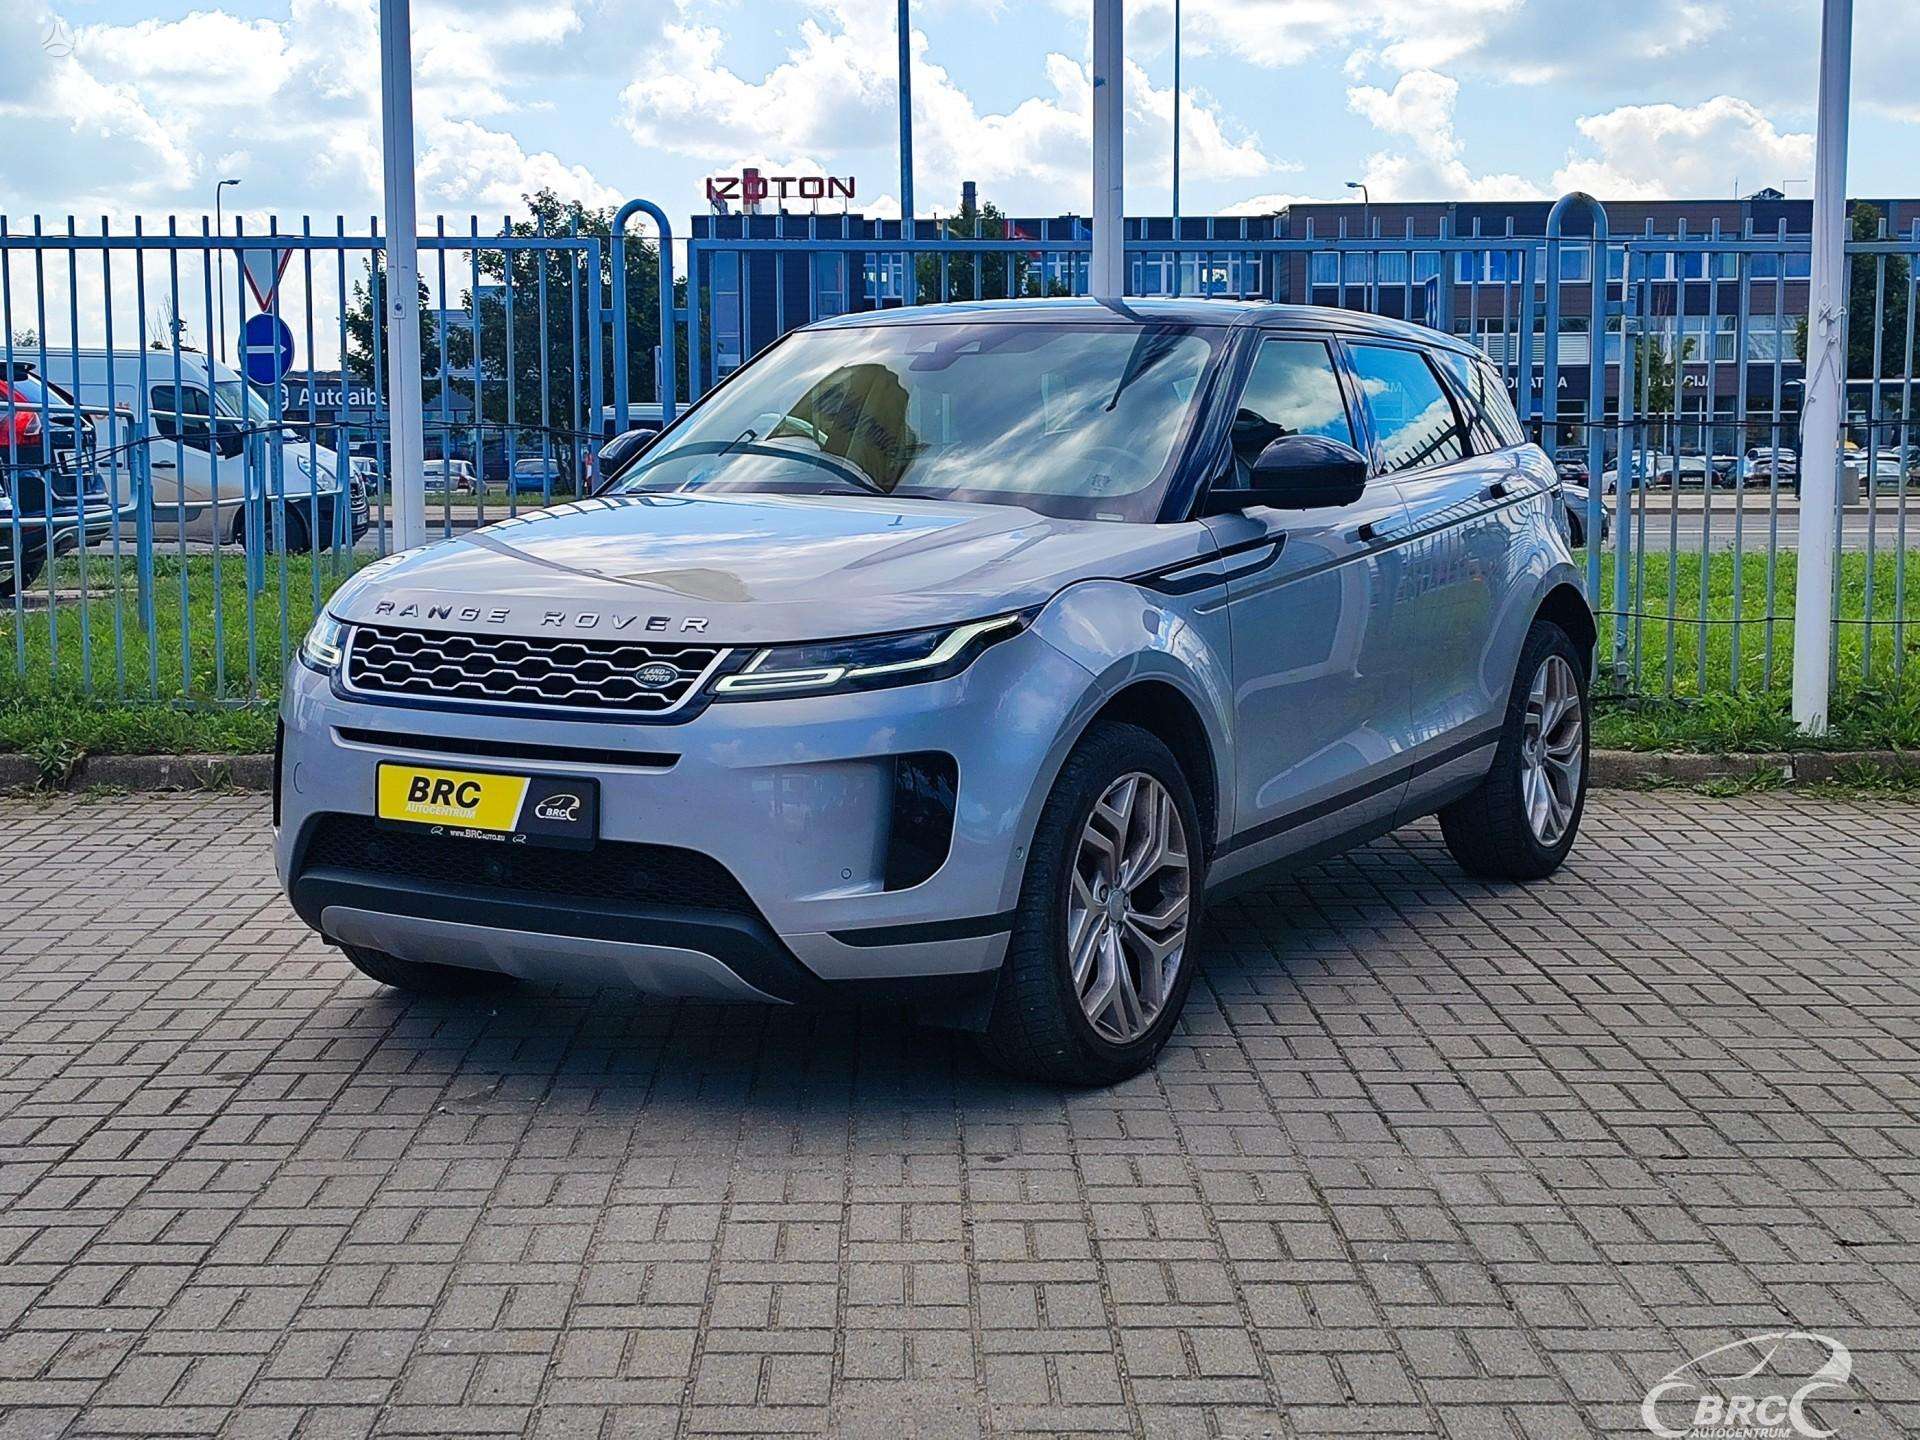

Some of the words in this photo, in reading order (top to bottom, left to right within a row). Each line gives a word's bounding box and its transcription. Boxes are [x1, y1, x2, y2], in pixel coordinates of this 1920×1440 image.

[706, 176, 855, 199] IZOTON
[374, 600, 510, 623] RANGE
[540, 610, 710, 634] ROVER
[643, 674, 671, 682] ROVER
[407, 776, 482, 809] BRC
[405, 802, 477, 820] AUTOCENTRUM
